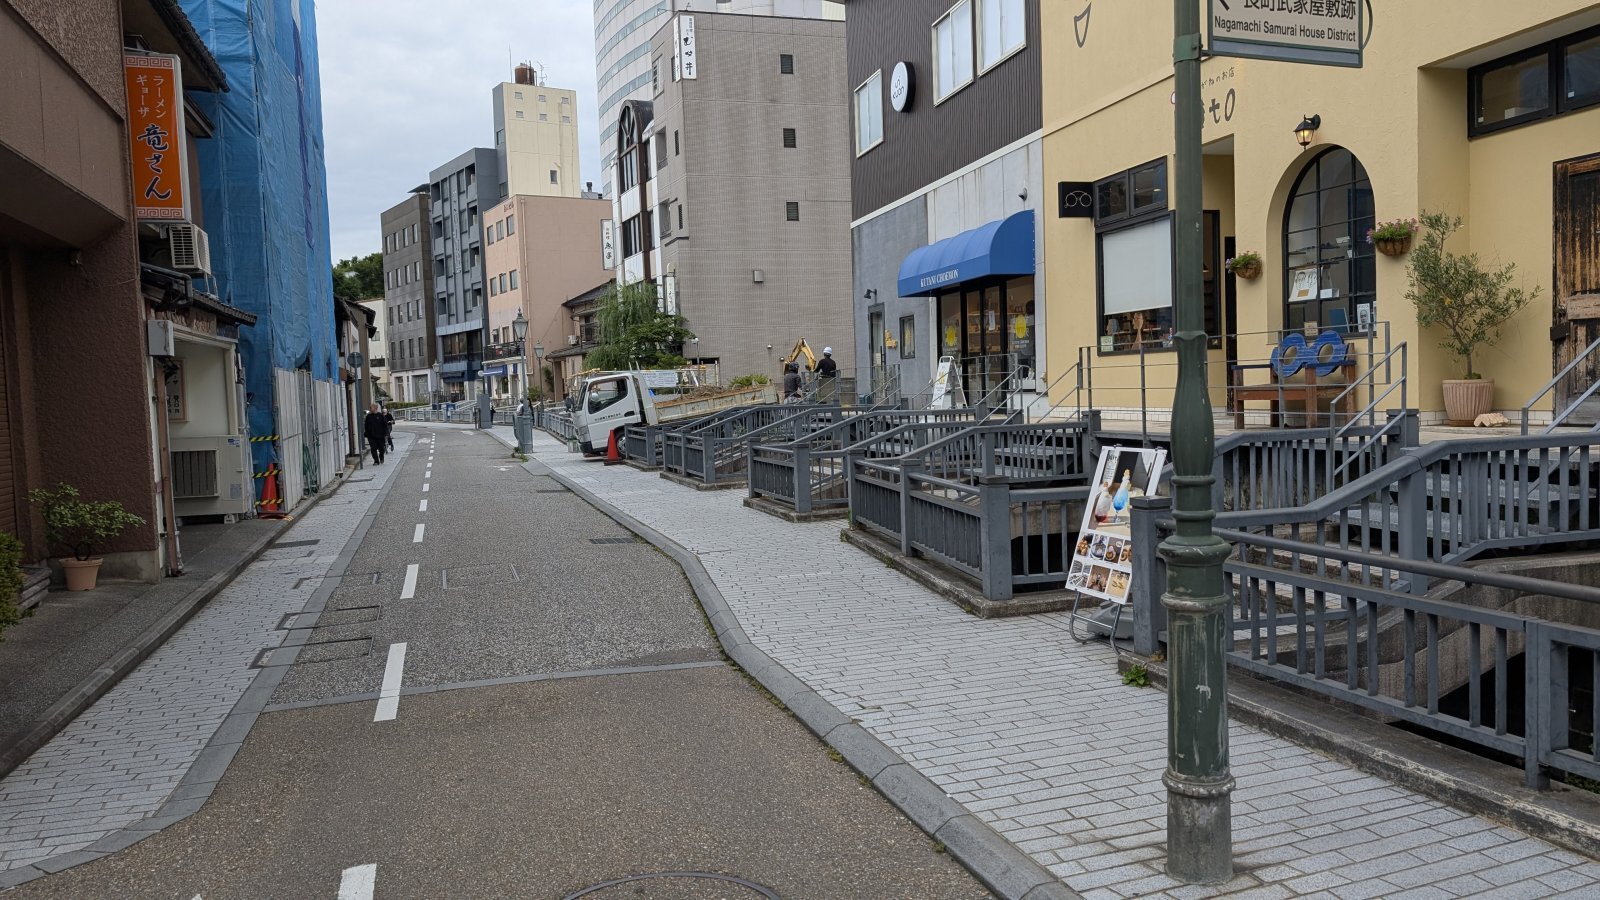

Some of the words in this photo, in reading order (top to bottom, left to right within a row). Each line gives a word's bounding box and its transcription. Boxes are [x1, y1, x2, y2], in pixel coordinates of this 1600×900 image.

[1214, 15, 1262, 33] Nagamachi
[1263, 21, 1297, 37] Samurai
[1299, 25, 1325, 40] House
[1327, 28, 1356, 42] District
[136, 74, 150, 118] ギョーザ
[152, 74, 167, 119] ラーメン
[137, 123, 172, 200] 竜さん
